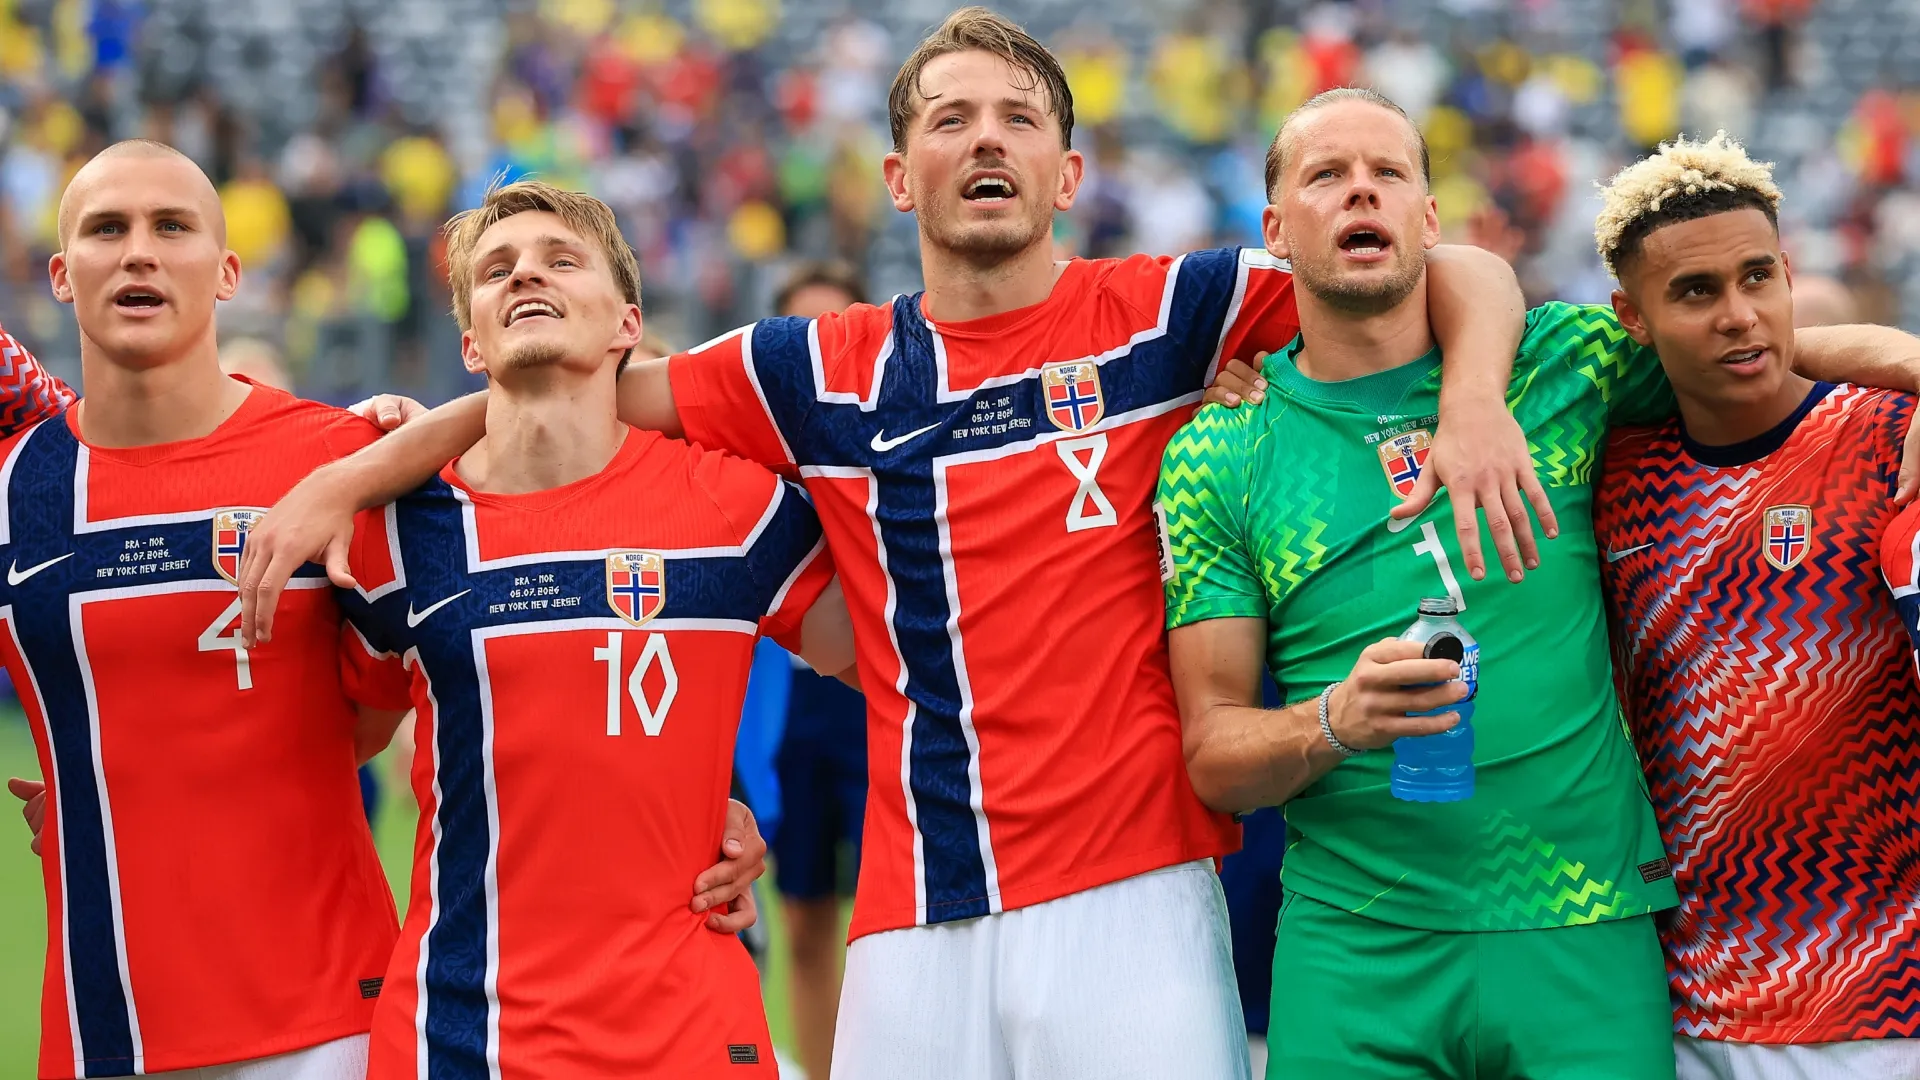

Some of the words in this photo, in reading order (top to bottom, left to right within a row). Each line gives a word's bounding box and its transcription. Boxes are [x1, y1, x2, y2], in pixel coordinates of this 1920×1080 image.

[1059, 366, 1077, 374] NORGE
[976, 400, 990, 410] BRA
[997, 396, 1010, 408] NOR
[952, 428, 969, 439] NEW
[970, 425, 990, 437] YORK
[992, 423, 1007, 434] NEW
[1008, 418, 1032, 430] JERSEY
[1364, 432, 1380, 444] NEW
[1380, 424, 1401, 439] YORK
[1401, 420, 1417, 432] NEW
[1394, 435, 1412, 447] NORGE
[1055, 432, 1118, 533] 8
[233, 512, 252, 520] NORGE
[125, 540, 140, 550] BRA
[149, 537, 165, 547] NOR
[625, 554, 644, 562] NORGE
[1412, 520, 1467, 611] 1
[96, 567, 114, 578] NEW
[116, 565, 138, 577] YORK
[139, 563, 157, 574] NEW
[159, 559, 191, 572] JERSEY
[514, 576, 530, 587] BRA
[538, 573, 555, 584] NOR
[509, 585, 560, 599] 05.07.2026
[489, 603, 506, 614] NEW
[507, 600, 529, 612] YORK
[531, 599, 549, 610] NEW
[550, 596, 582, 608] JERSEY
[198, 597, 254, 691] 4
[593, 631, 679, 737] 10
